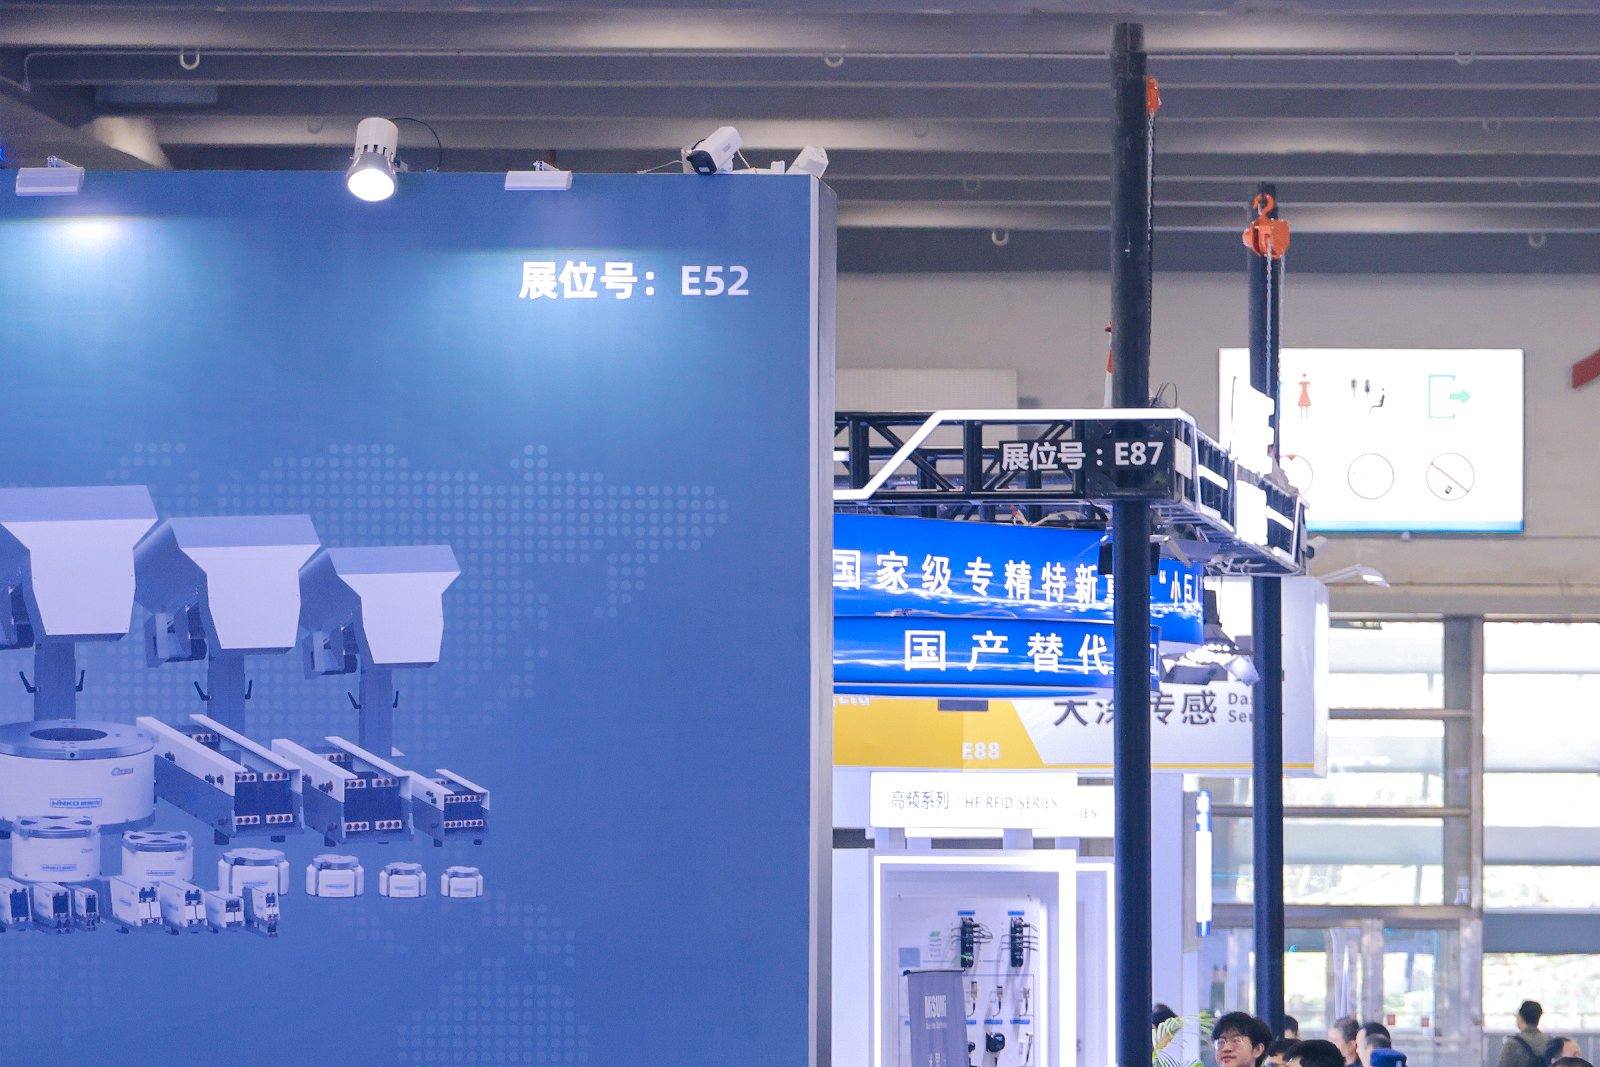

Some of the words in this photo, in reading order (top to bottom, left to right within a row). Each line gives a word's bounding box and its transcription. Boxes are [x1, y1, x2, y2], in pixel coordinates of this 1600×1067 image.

[904, 630, 1157, 676] 国产替代
[962, 741, 1001, 760] E88
[891, 789, 950, 810] 高频系列
[1018, 796, 1058, 810] SERIES
